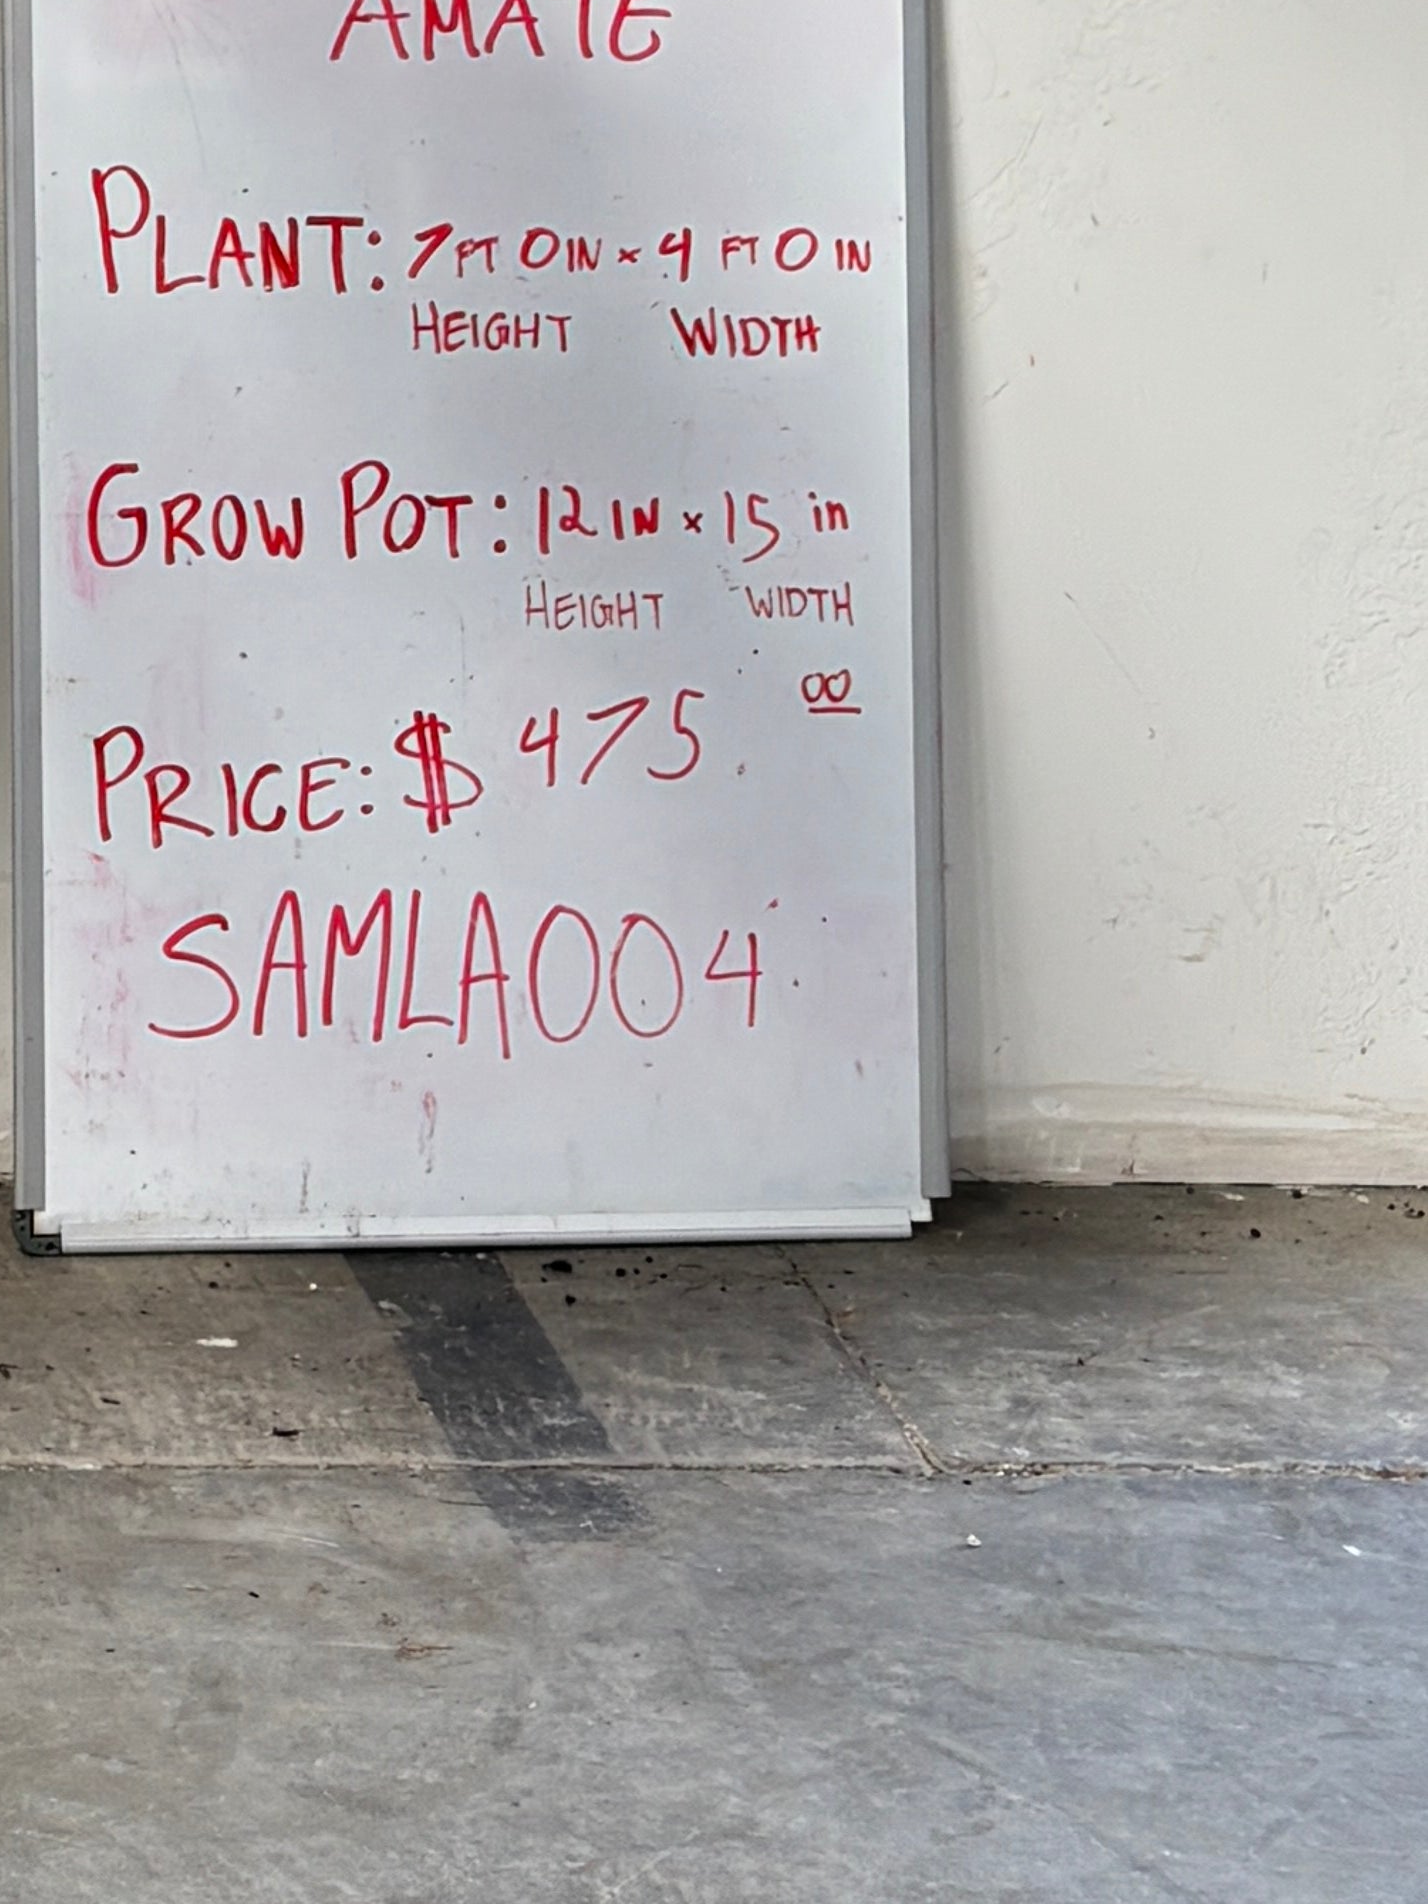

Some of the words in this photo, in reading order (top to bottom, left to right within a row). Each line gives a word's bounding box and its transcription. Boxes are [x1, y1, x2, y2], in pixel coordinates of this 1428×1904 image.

[89, 163, 386, 296] PLANT:
[411, 300, 574, 354] HEIGHT
[670, 307, 822, 358] WIDTH
[84, 461, 306, 569] GROW
[339, 458, 511, 561] POT:
[524, 578, 666, 631] HEIGHT
[744, 580, 856, 628] WIDTH
[91, 723, 376, 851] PRICE:
[147, 887, 765, 1061] SAMLA004
